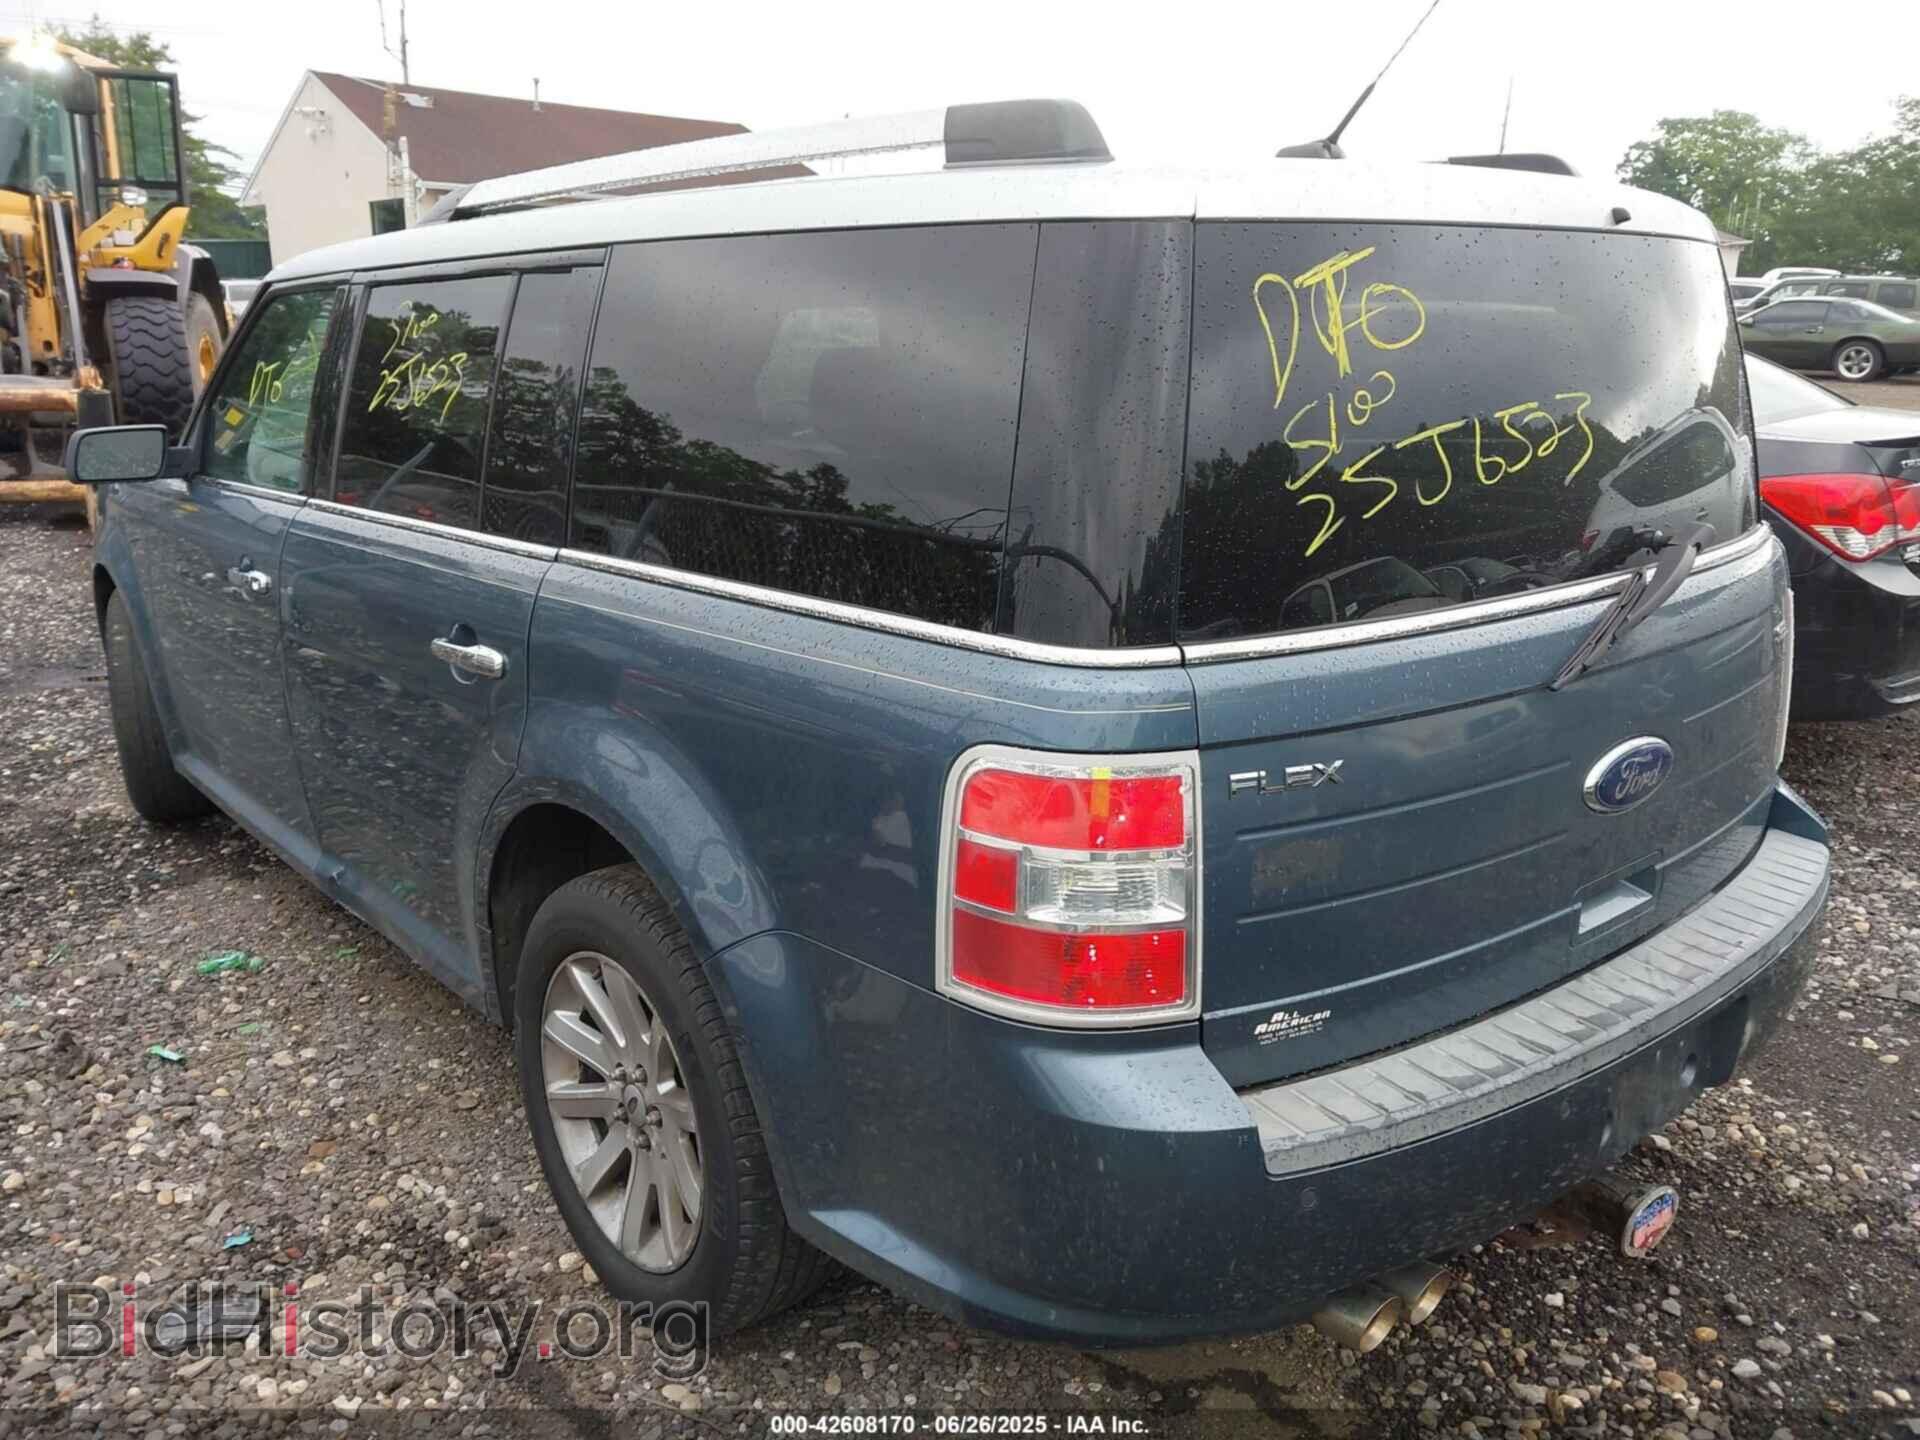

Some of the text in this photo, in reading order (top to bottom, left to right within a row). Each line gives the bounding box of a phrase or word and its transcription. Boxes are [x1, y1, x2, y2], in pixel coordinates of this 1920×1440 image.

[1295, 391, 1594, 558] 25J6523
[1228, 759, 1345, 801] FLEX
[1615, 755, 1661, 800] Ford
